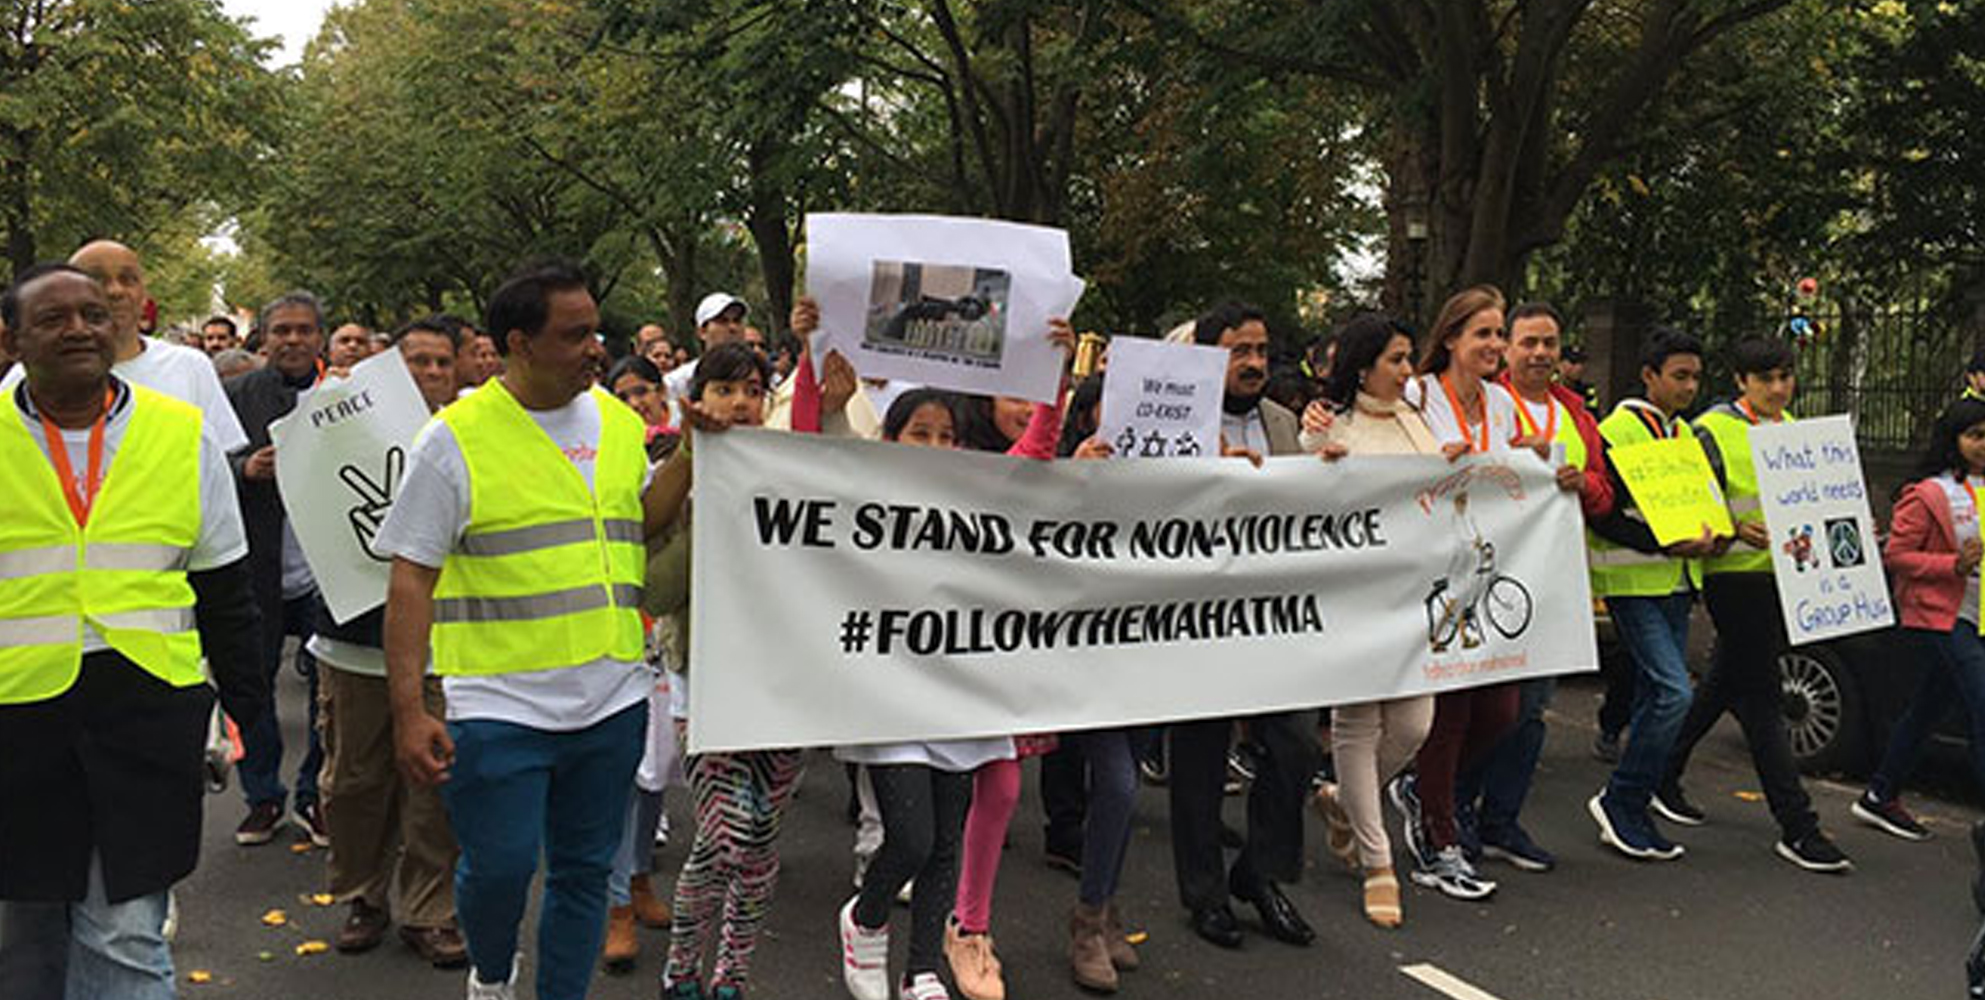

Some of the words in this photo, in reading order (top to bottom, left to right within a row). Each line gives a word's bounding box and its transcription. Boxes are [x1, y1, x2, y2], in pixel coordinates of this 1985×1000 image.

[311, 388, 374, 428] PEACE
[1763, 445, 1816, 471] What
[1776, 480, 1819, 504] world
[1822, 480, 1863, 500] needs
[754, 497, 836, 548] WE
[852, 503, 1014, 555] STAND
[1028, 520, 1118, 559] FOR
[1130, 509, 1386, 559] NON-VIOLENCE
[840, 594, 1323, 655] #FOLLOWTHEMAHATMA
